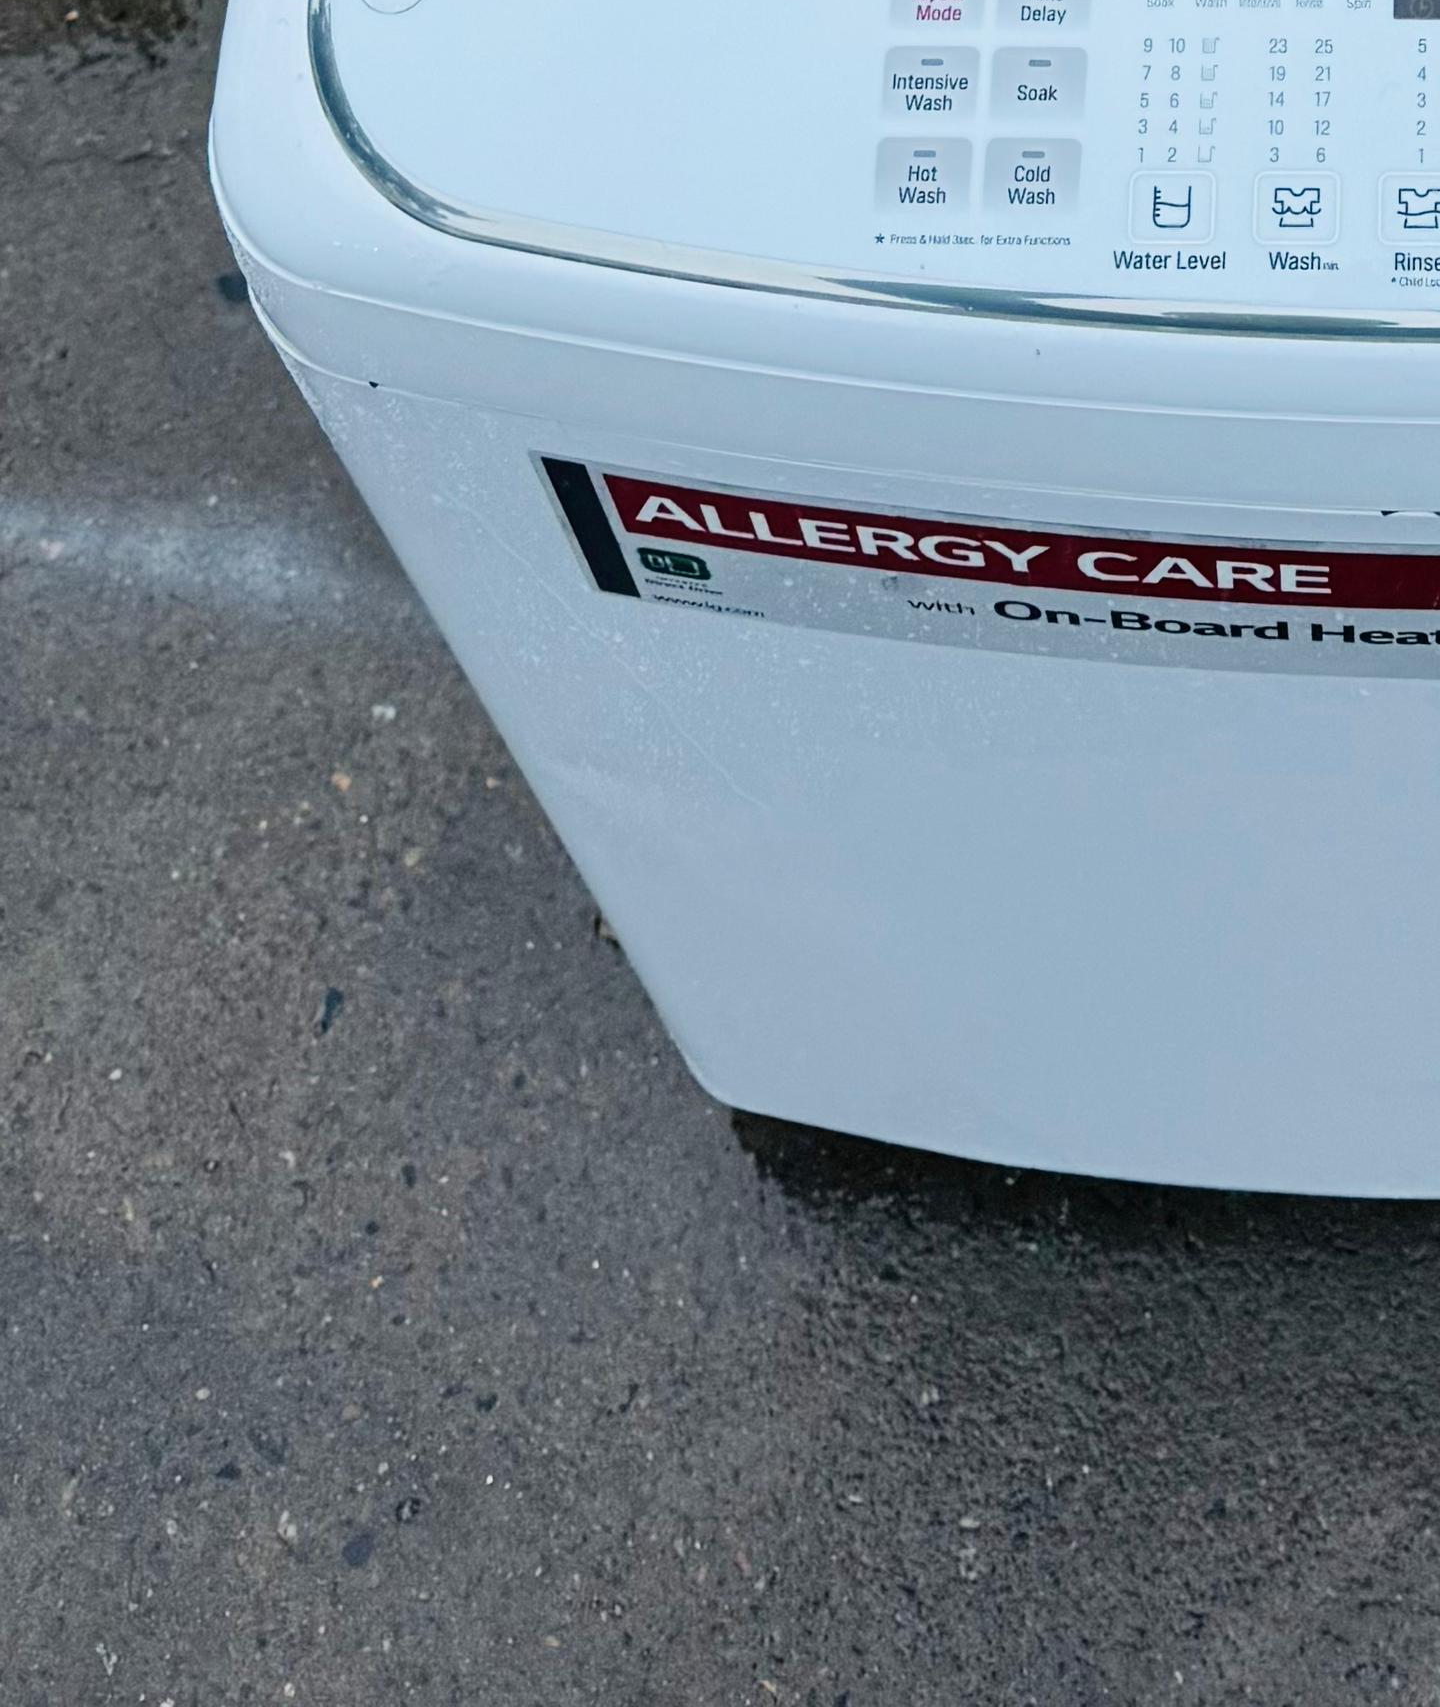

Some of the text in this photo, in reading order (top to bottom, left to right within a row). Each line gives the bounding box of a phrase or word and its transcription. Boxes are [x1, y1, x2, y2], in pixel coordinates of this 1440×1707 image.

[916, 5, 962, 22] Mode
[1020, 5, 1066, 26] Delay
[1143, 38, 1185, 53] 9 10
[1269, 38, 1333, 54] 23 25
[1418, 39, 1427, 54] 5
[1143, 66, 1180, 81] 7 8
[1271, 66, 1331, 81] 19 21
[1417, 67, 1426, 82] 4
[892, 73, 968, 91] Intensive
[1016, 84, 1058, 102] Soak
[1140, 93, 1179, 108] 5 6
[1269, 92, 1330, 106] 14 17
[1417, 93, 1426, 108] 3
[904, 93, 952, 112] Wash
[1138, 119, 1178, 134] 3 4
[1269, 120, 1330, 135] 10 12
[1417, 121, 1426, 136] 2
[1168, 148, 1176, 162] 2
[1270, 148, 1326, 162] 3 6
[1419, 148, 1424, 164] 1
[908, 165, 938, 183] Hot
[1013, 165, 1051, 183] Cold
[898, 186, 946, 205] Wash
[1007, 187, 1056, 206] Wash
[981, 235, 993, 245] for
[997, 236, 1022, 245] Extra
[1024, 236, 1070, 246] Functions
[1113, 250, 1226, 270] Water Level
[1269, 251, 1320, 270] Wash
[1399, 277, 1422, 287] Child
[635, 496, 1332, 594] ALLERGY CARE
[908, 598, 976, 616] with
[994, 600, 1288, 641] On-Board
